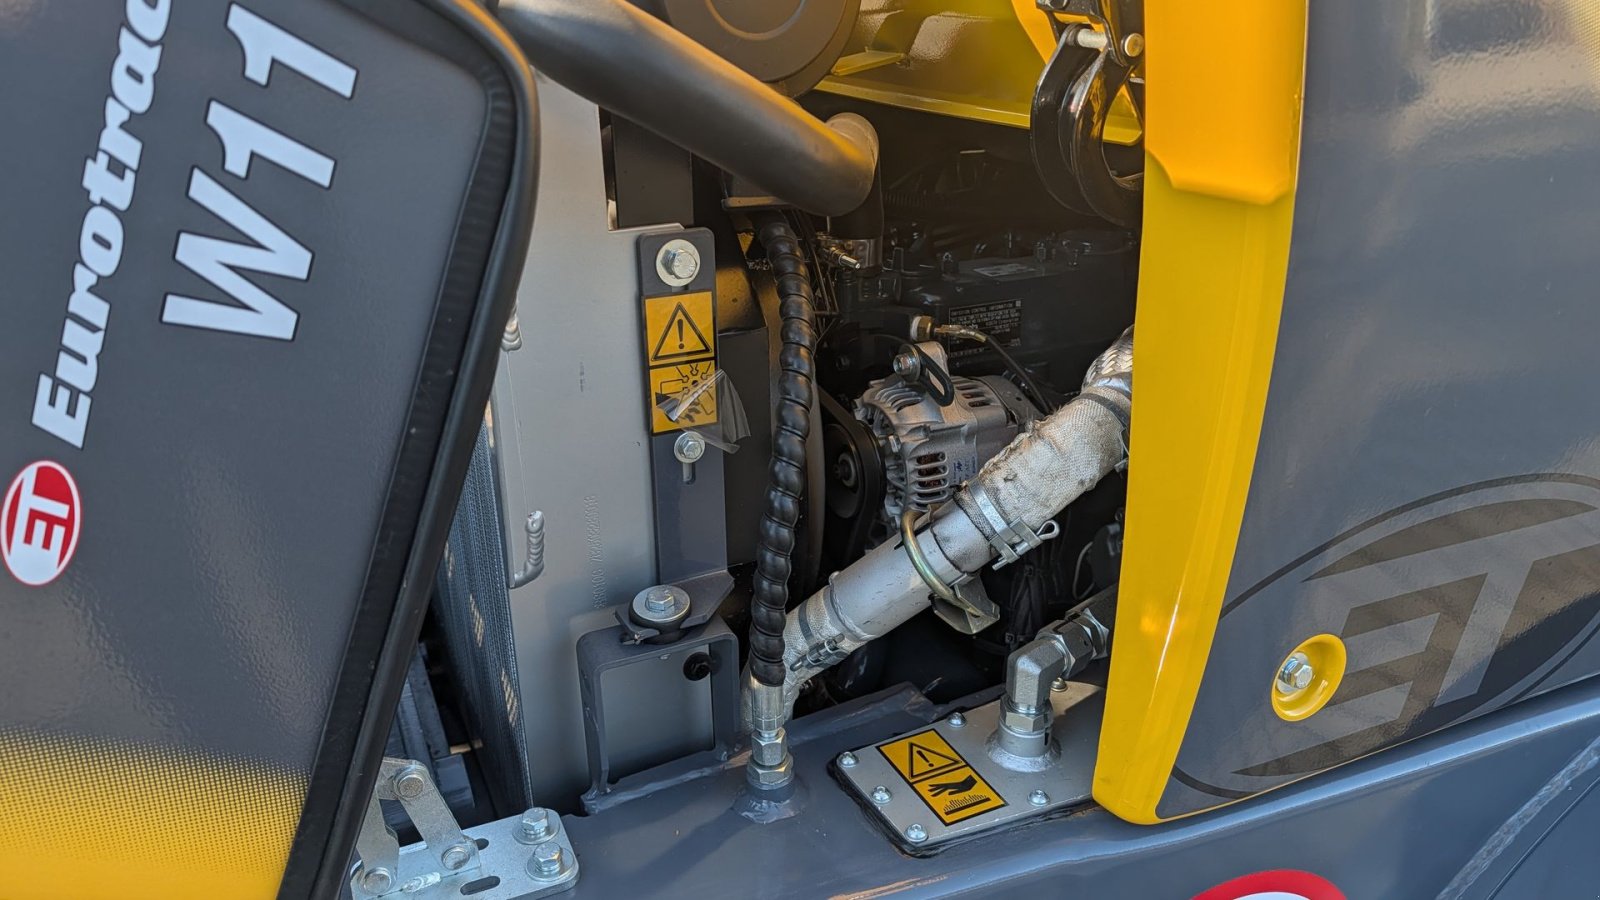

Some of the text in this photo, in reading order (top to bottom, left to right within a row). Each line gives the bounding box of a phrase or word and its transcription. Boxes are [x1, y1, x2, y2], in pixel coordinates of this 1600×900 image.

[159, 1, 359, 342] W11
[2, 462, 79, 583] ET
[1250, 500, 1600, 775] ET
